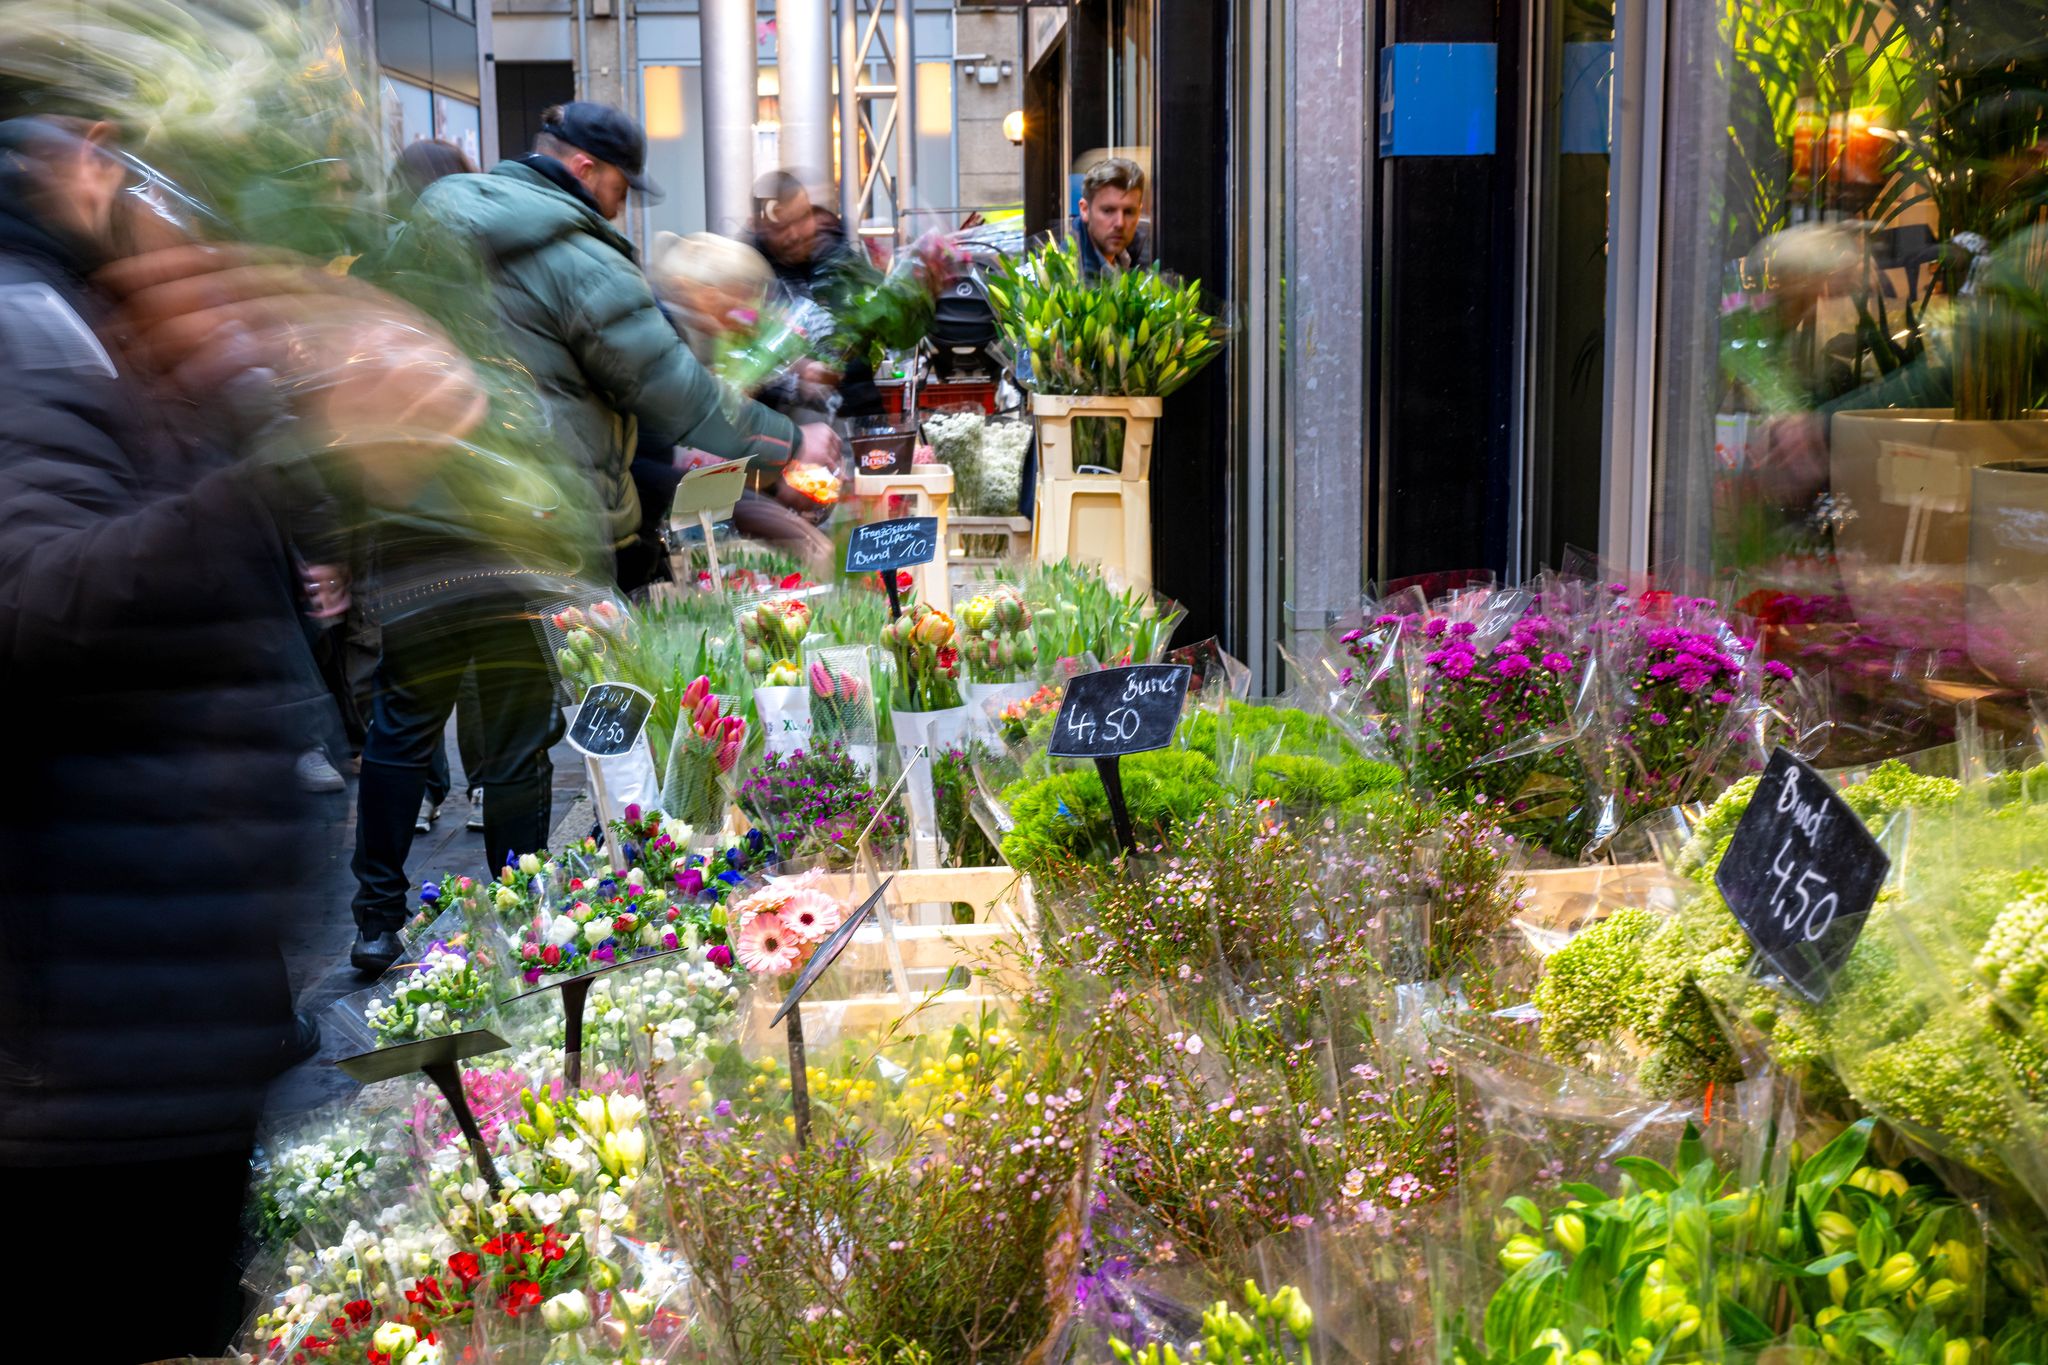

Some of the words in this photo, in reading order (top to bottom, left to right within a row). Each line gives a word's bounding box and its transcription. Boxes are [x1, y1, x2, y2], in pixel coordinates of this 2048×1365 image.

[854, 549, 890, 565] Bund
[1067, 703, 1141, 745] 4,50
[1777, 765, 1831, 848] Bund
[1769, 838, 1840, 942] 4,50
